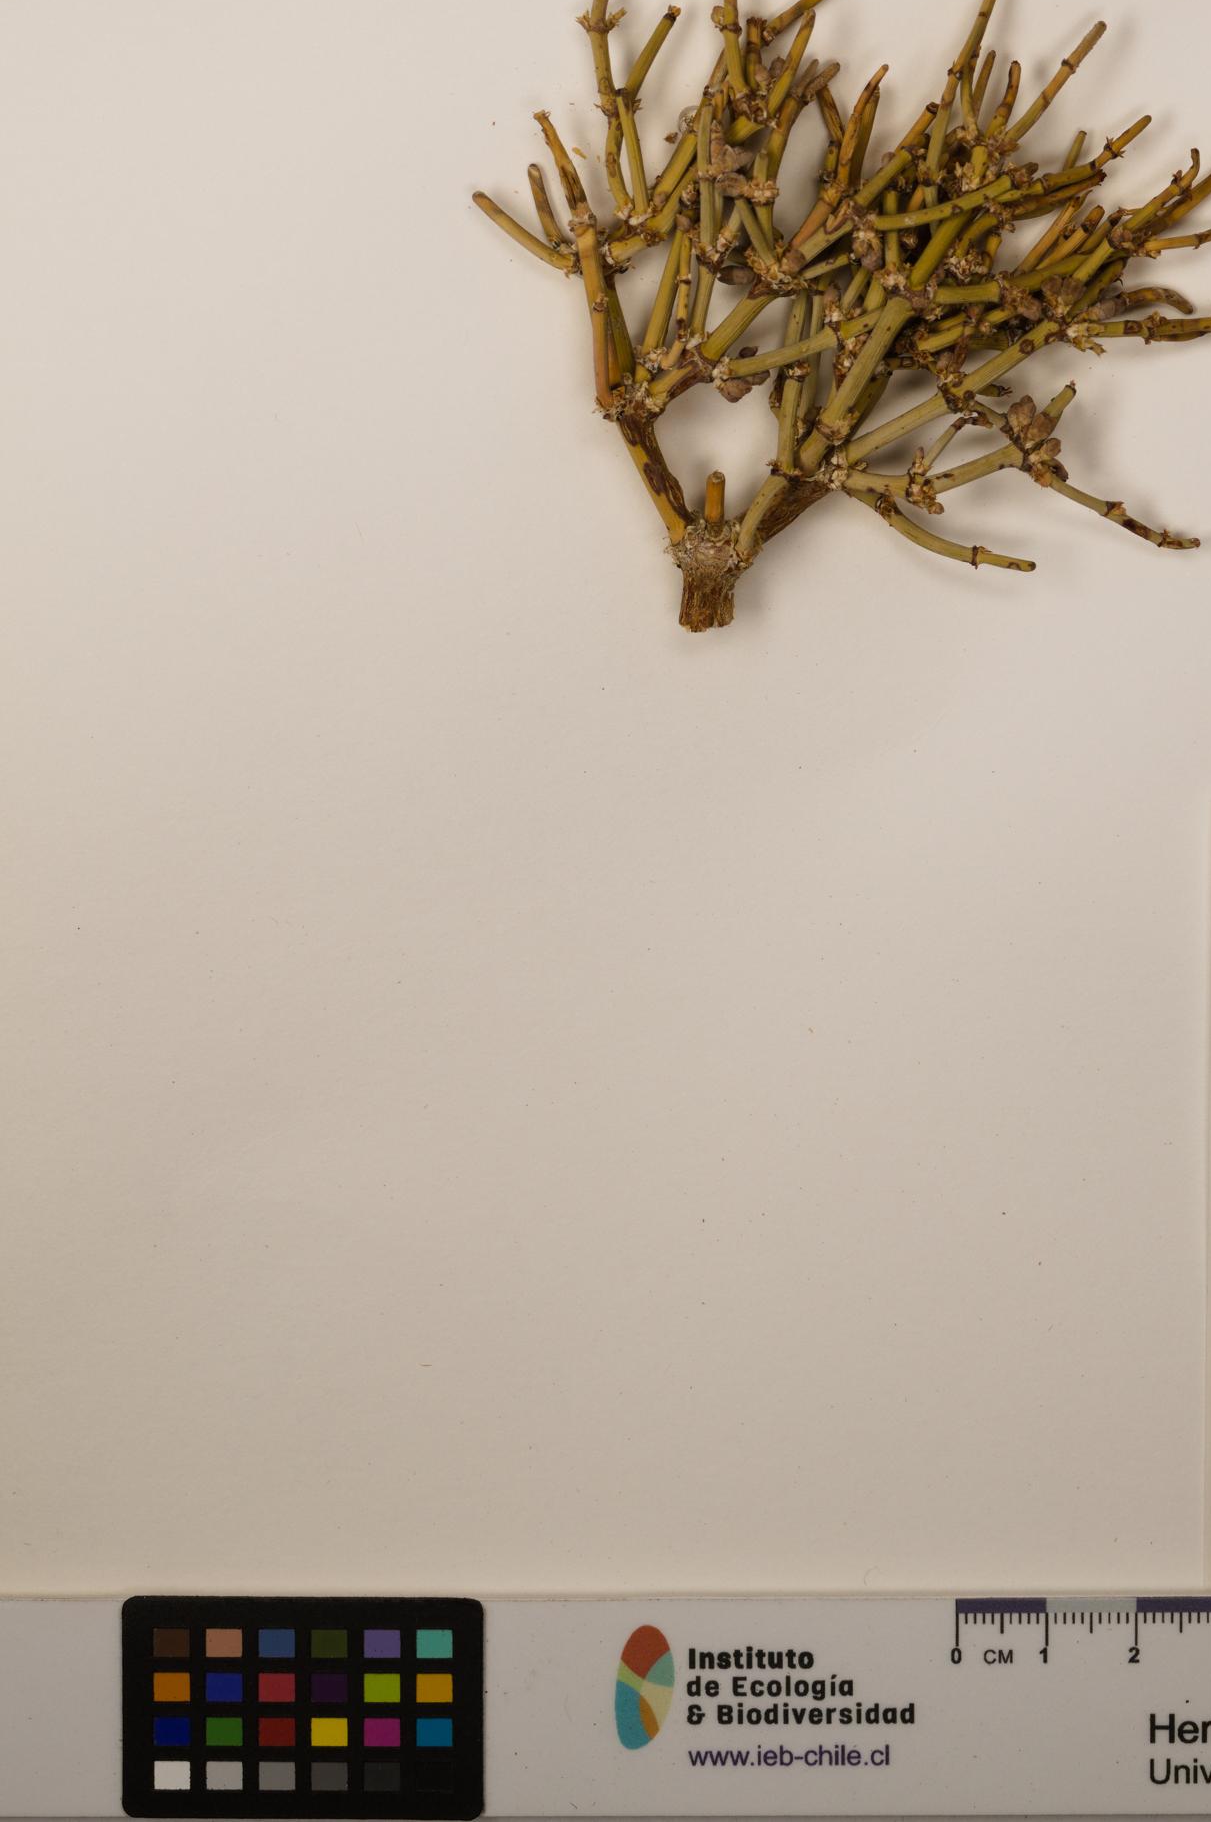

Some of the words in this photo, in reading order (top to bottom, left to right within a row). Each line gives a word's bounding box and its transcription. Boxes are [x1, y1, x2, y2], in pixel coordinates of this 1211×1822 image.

[688, 1645, 815, 1670] Instituto
[950, 1648, 963, 1665] 0
[983, 1649, 1014, 1665] CM
[1039, 1647, 1049, 1664] 1
[1127, 1647, 1141, 1664] 2
[686, 1675, 720, 1698] de
[731, 1673, 854, 1702] Ecología
[686, 1703, 706, 1726] &
[716, 1702, 916, 1726] Biodiversidad
[687, 1744, 891, 1767] www.ieb-chile.cl
